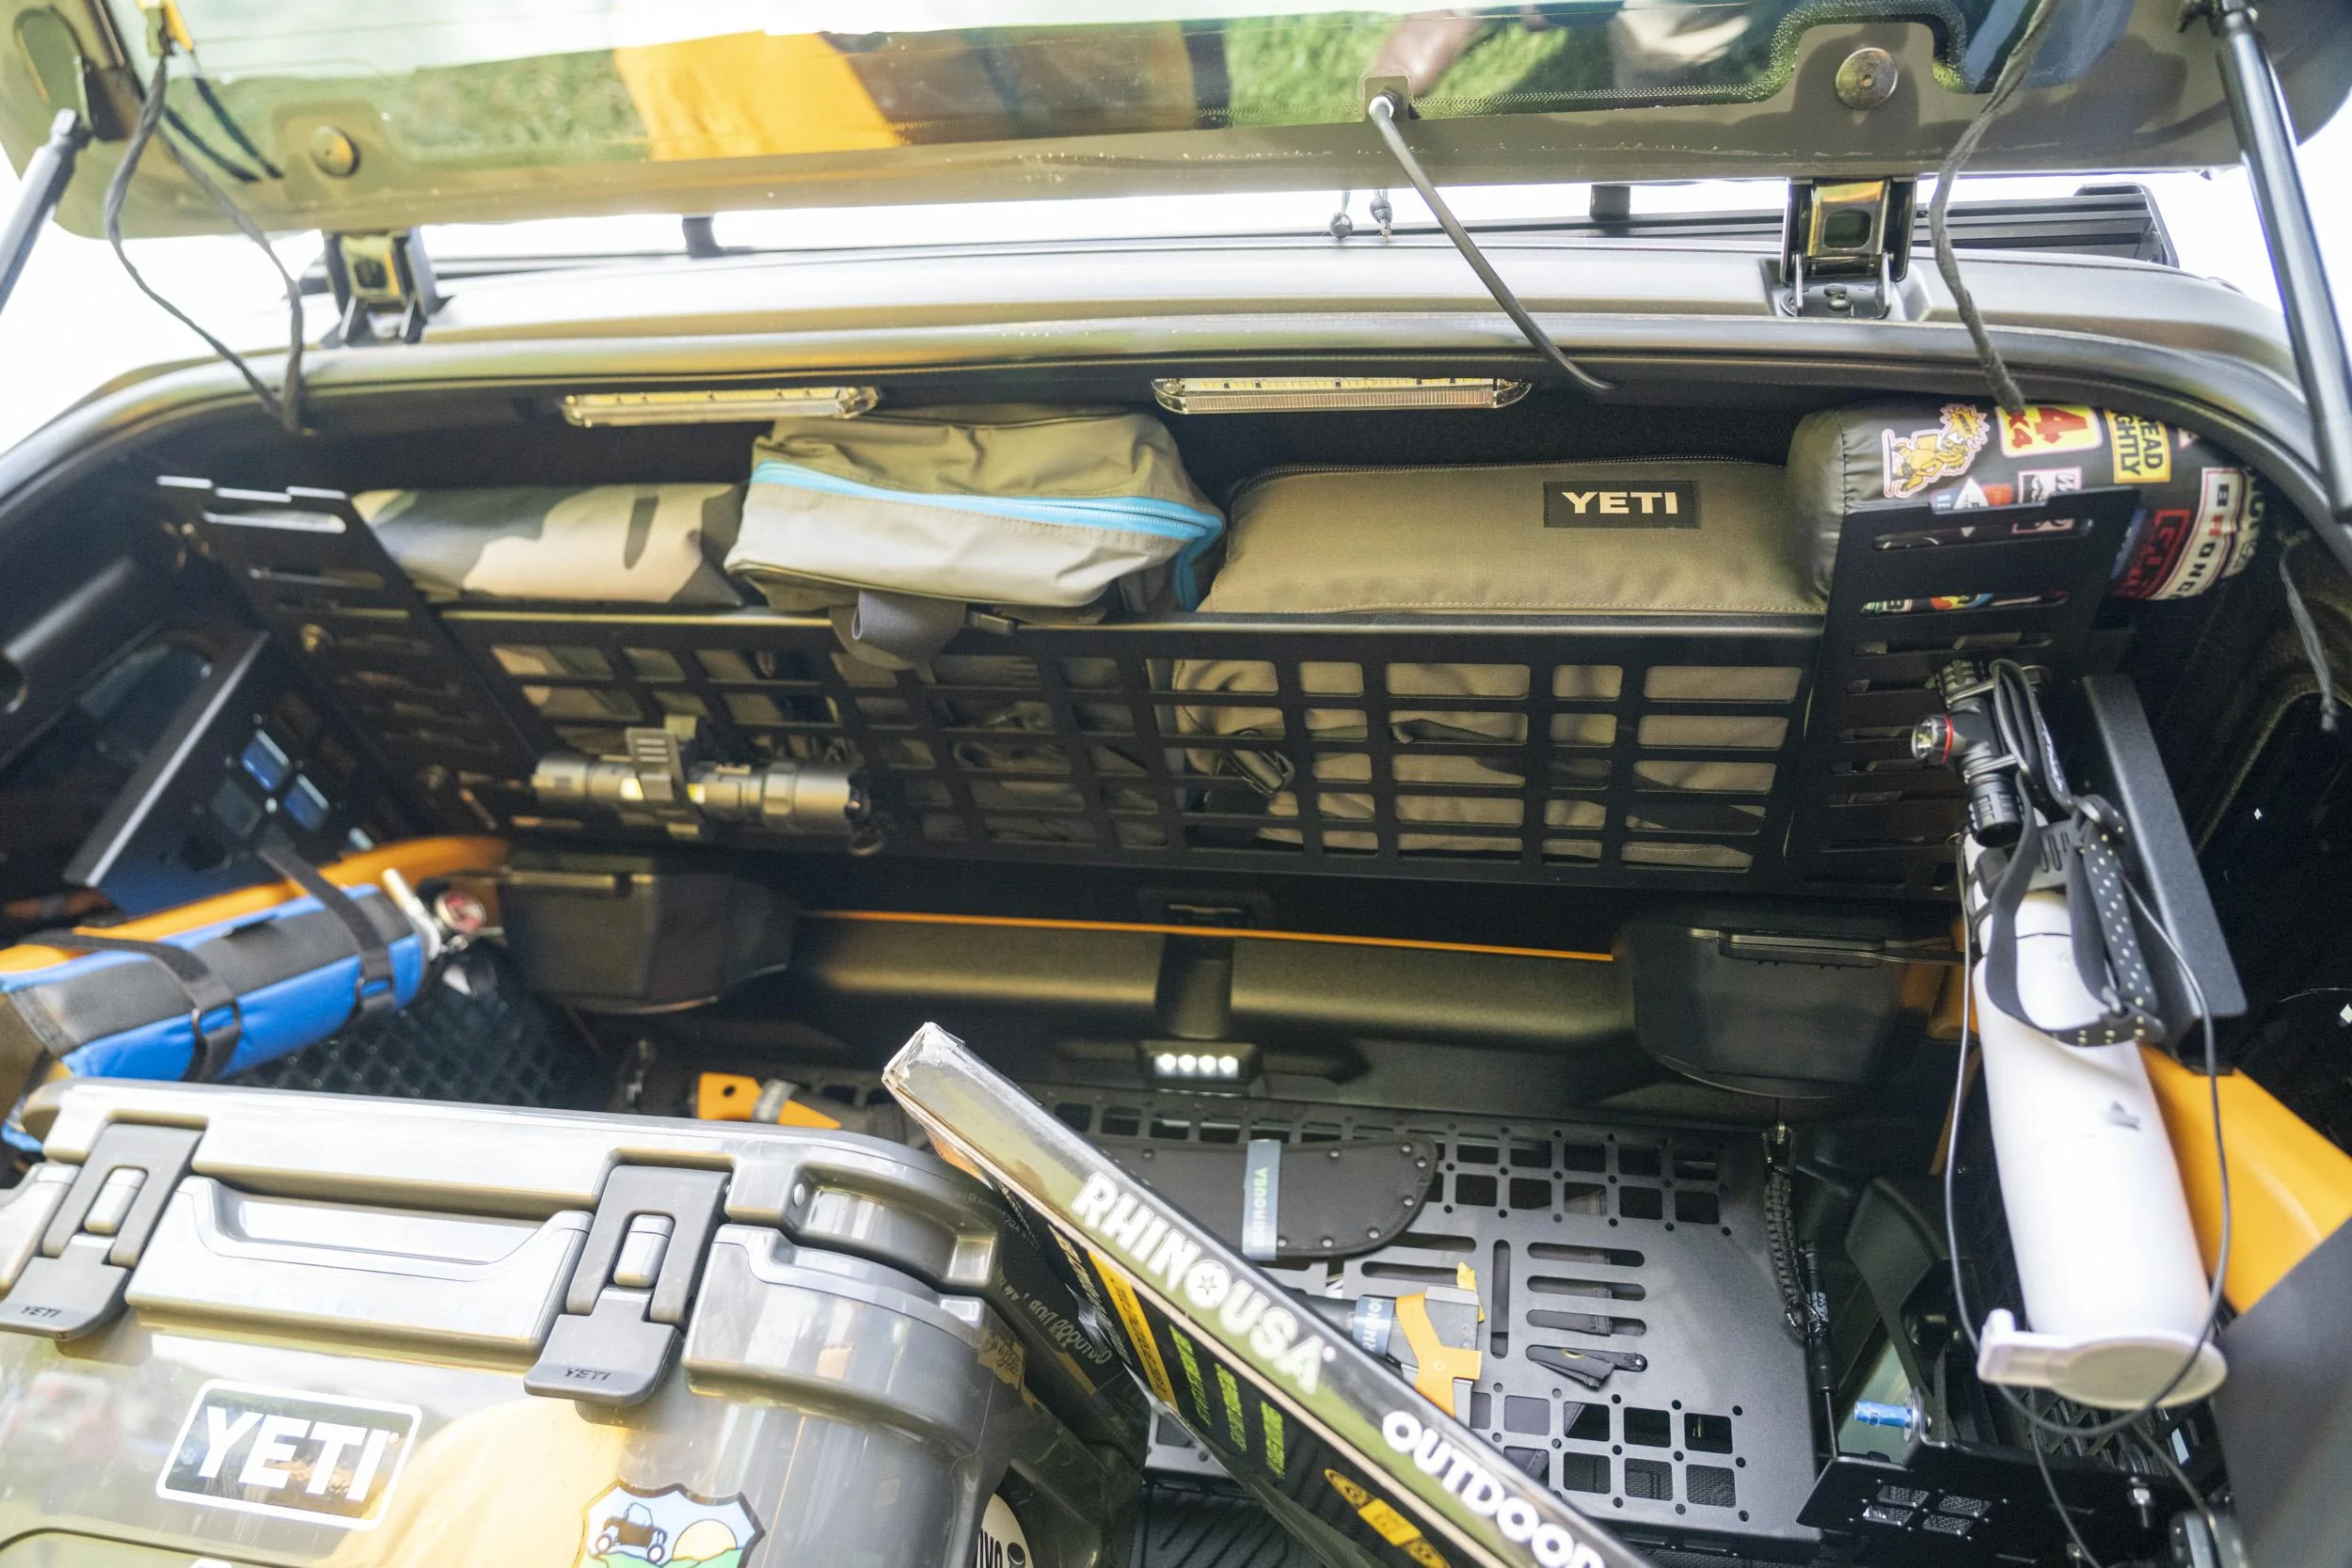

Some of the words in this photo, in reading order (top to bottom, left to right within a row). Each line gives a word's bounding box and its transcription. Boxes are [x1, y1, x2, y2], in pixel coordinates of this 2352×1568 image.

[2114, 414, 2142, 476] GHTLY
[2138, 418, 2164, 469] EAD
[1561, 491, 1678, 515] YETI
[21, 1306, 62, 1318] YETI
[564, 1368, 612, 1381] YETI
[198, 1406, 391, 1501] YETI
